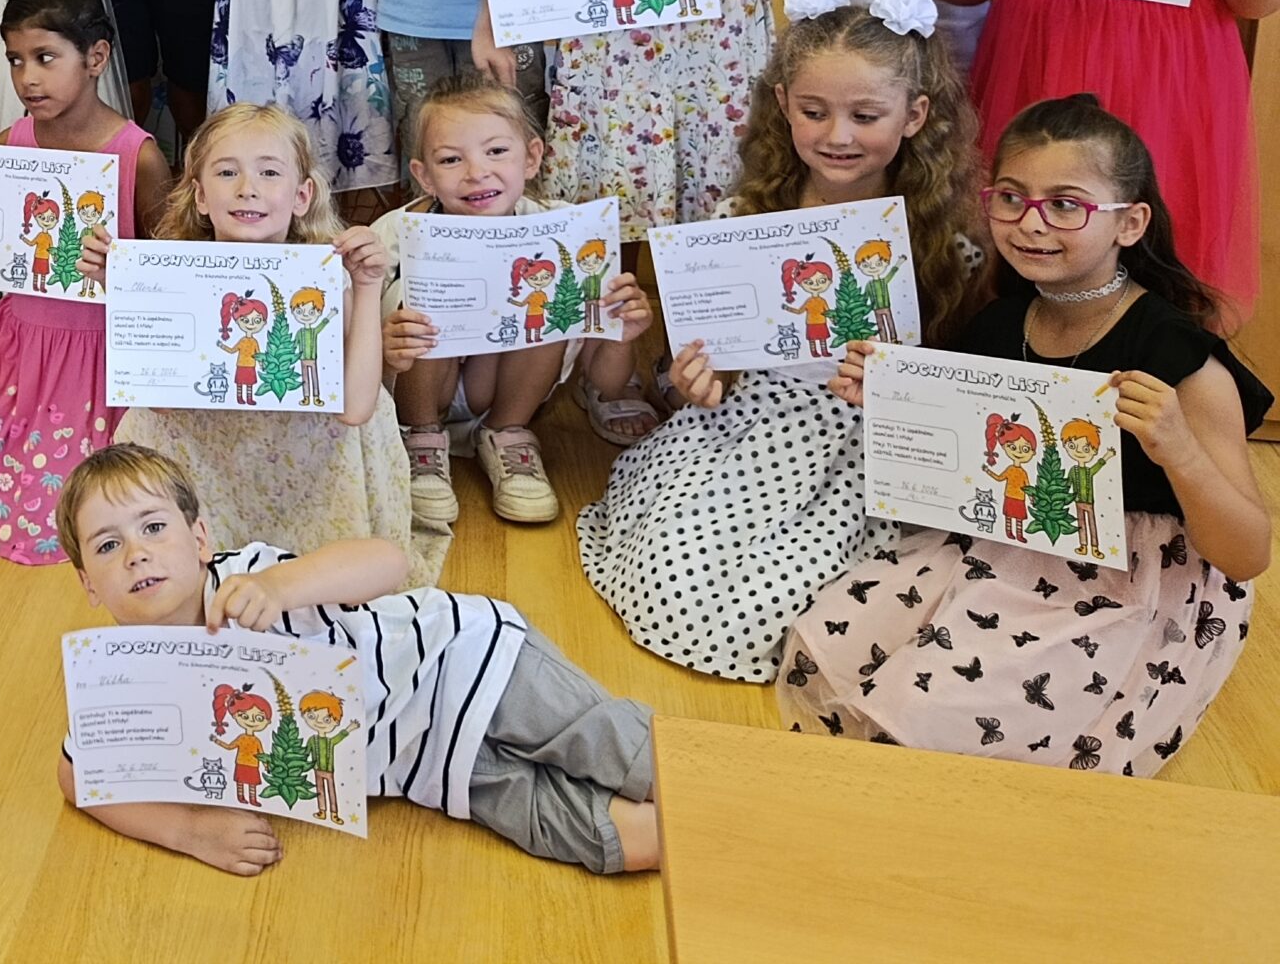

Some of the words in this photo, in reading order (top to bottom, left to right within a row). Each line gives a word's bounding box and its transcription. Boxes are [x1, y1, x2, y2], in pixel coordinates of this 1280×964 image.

[42, 161, 71, 174] LIST
[430, 225, 529, 239] POCHVALNÝ
[533, 220, 569, 236] LIST
[686, 223, 794, 247] POCHVALNÝ
[798, 218, 841, 234] LIST
[139, 253, 239, 270] POCHVALNÝ
[243, 257, 282, 270] LIST
[896, 360, 1003, 387] POCHVALNÝ
[1007, 374, 1049, 394] LIST
[105, 640, 233, 659] POCHVALNÝ
[237, 645, 287, 666] LIST
